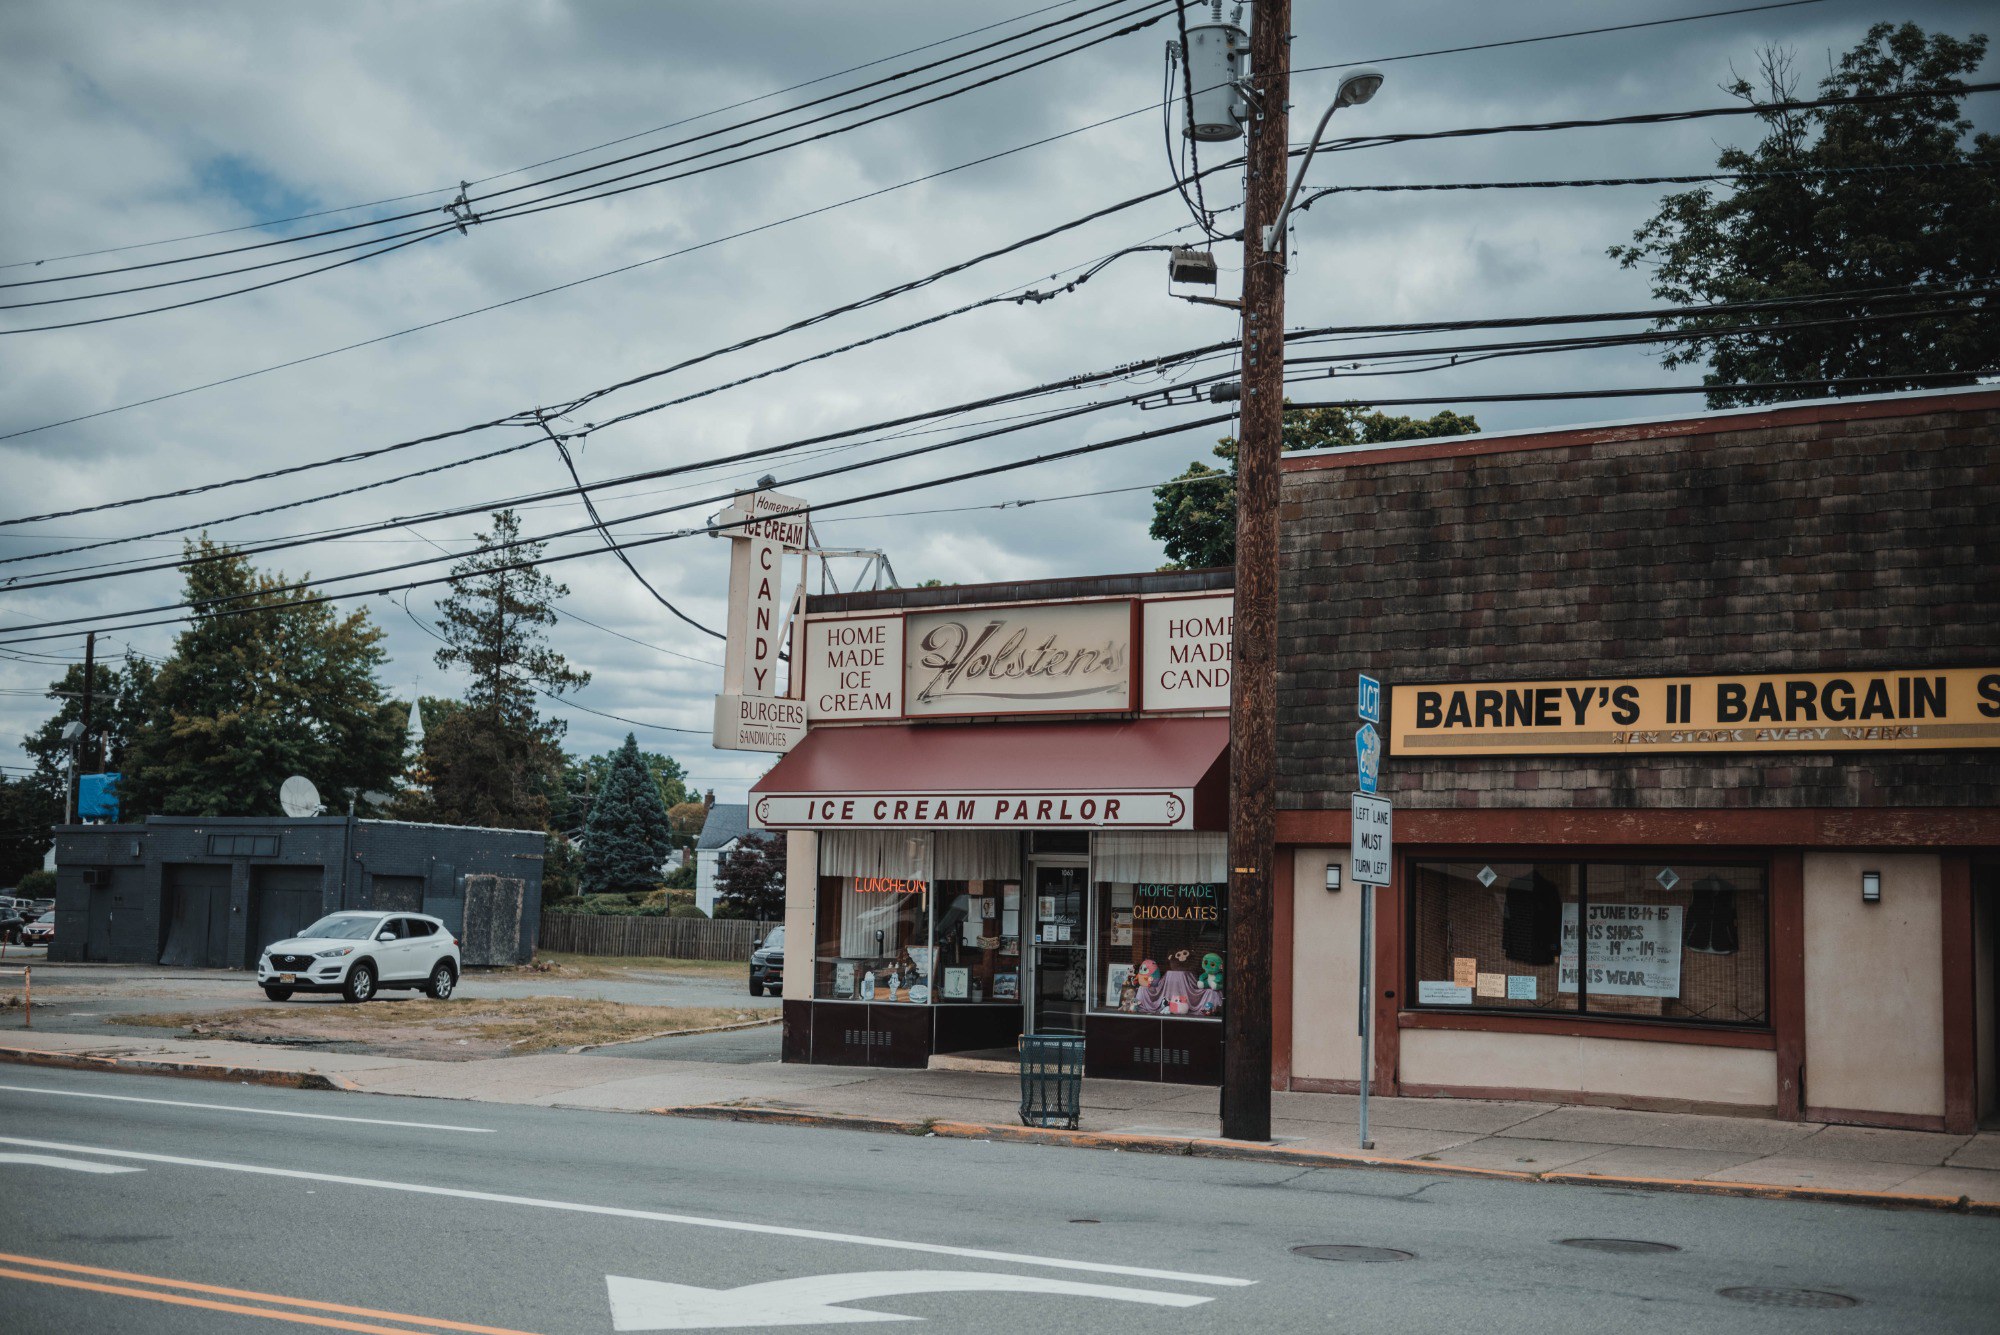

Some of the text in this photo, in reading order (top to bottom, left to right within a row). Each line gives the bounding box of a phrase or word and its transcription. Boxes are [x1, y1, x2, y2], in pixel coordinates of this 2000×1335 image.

[744, 514, 803, 545] ICE CREAM
[753, 547, 773, 691] CANDY
[827, 625, 886, 646] HOME
[827, 648, 885, 668] MADE
[840, 671, 871, 689] ICE
[1159, 668, 1232, 691] CAND
[819, 692, 891, 712] CREAM
[1360, 683, 1379, 716] JCT
[1416, 685, 1640, 729] BARNEY'S
[1666, 683, 1692, 724] II
[1716, 676, 1947, 724] BARGAIN
[741, 701, 804, 724] BURGERS
[739, 730, 787, 747] SANDWICHES
[1612, 725, 1918, 744] NEW STOCK EVERY WEEK!
[807, 799, 1122, 820] ICE CREAM PARLOR
[1355, 806, 1388, 825] LEFT LANE
[1361, 832, 1382, 850] MUST
[1355, 859, 1387, 875] TURN LEFT
[855, 877, 926, 893] LUNCHEON
[1139, 884, 1213, 898] HOME MADE
[1133, 905, 1218, 920] CHOCOLATES
[1589, 906, 1626, 920] JUNE
[1606, 925, 1644, 940] SHOES
[1606, 970, 1646, 986] WEAR
